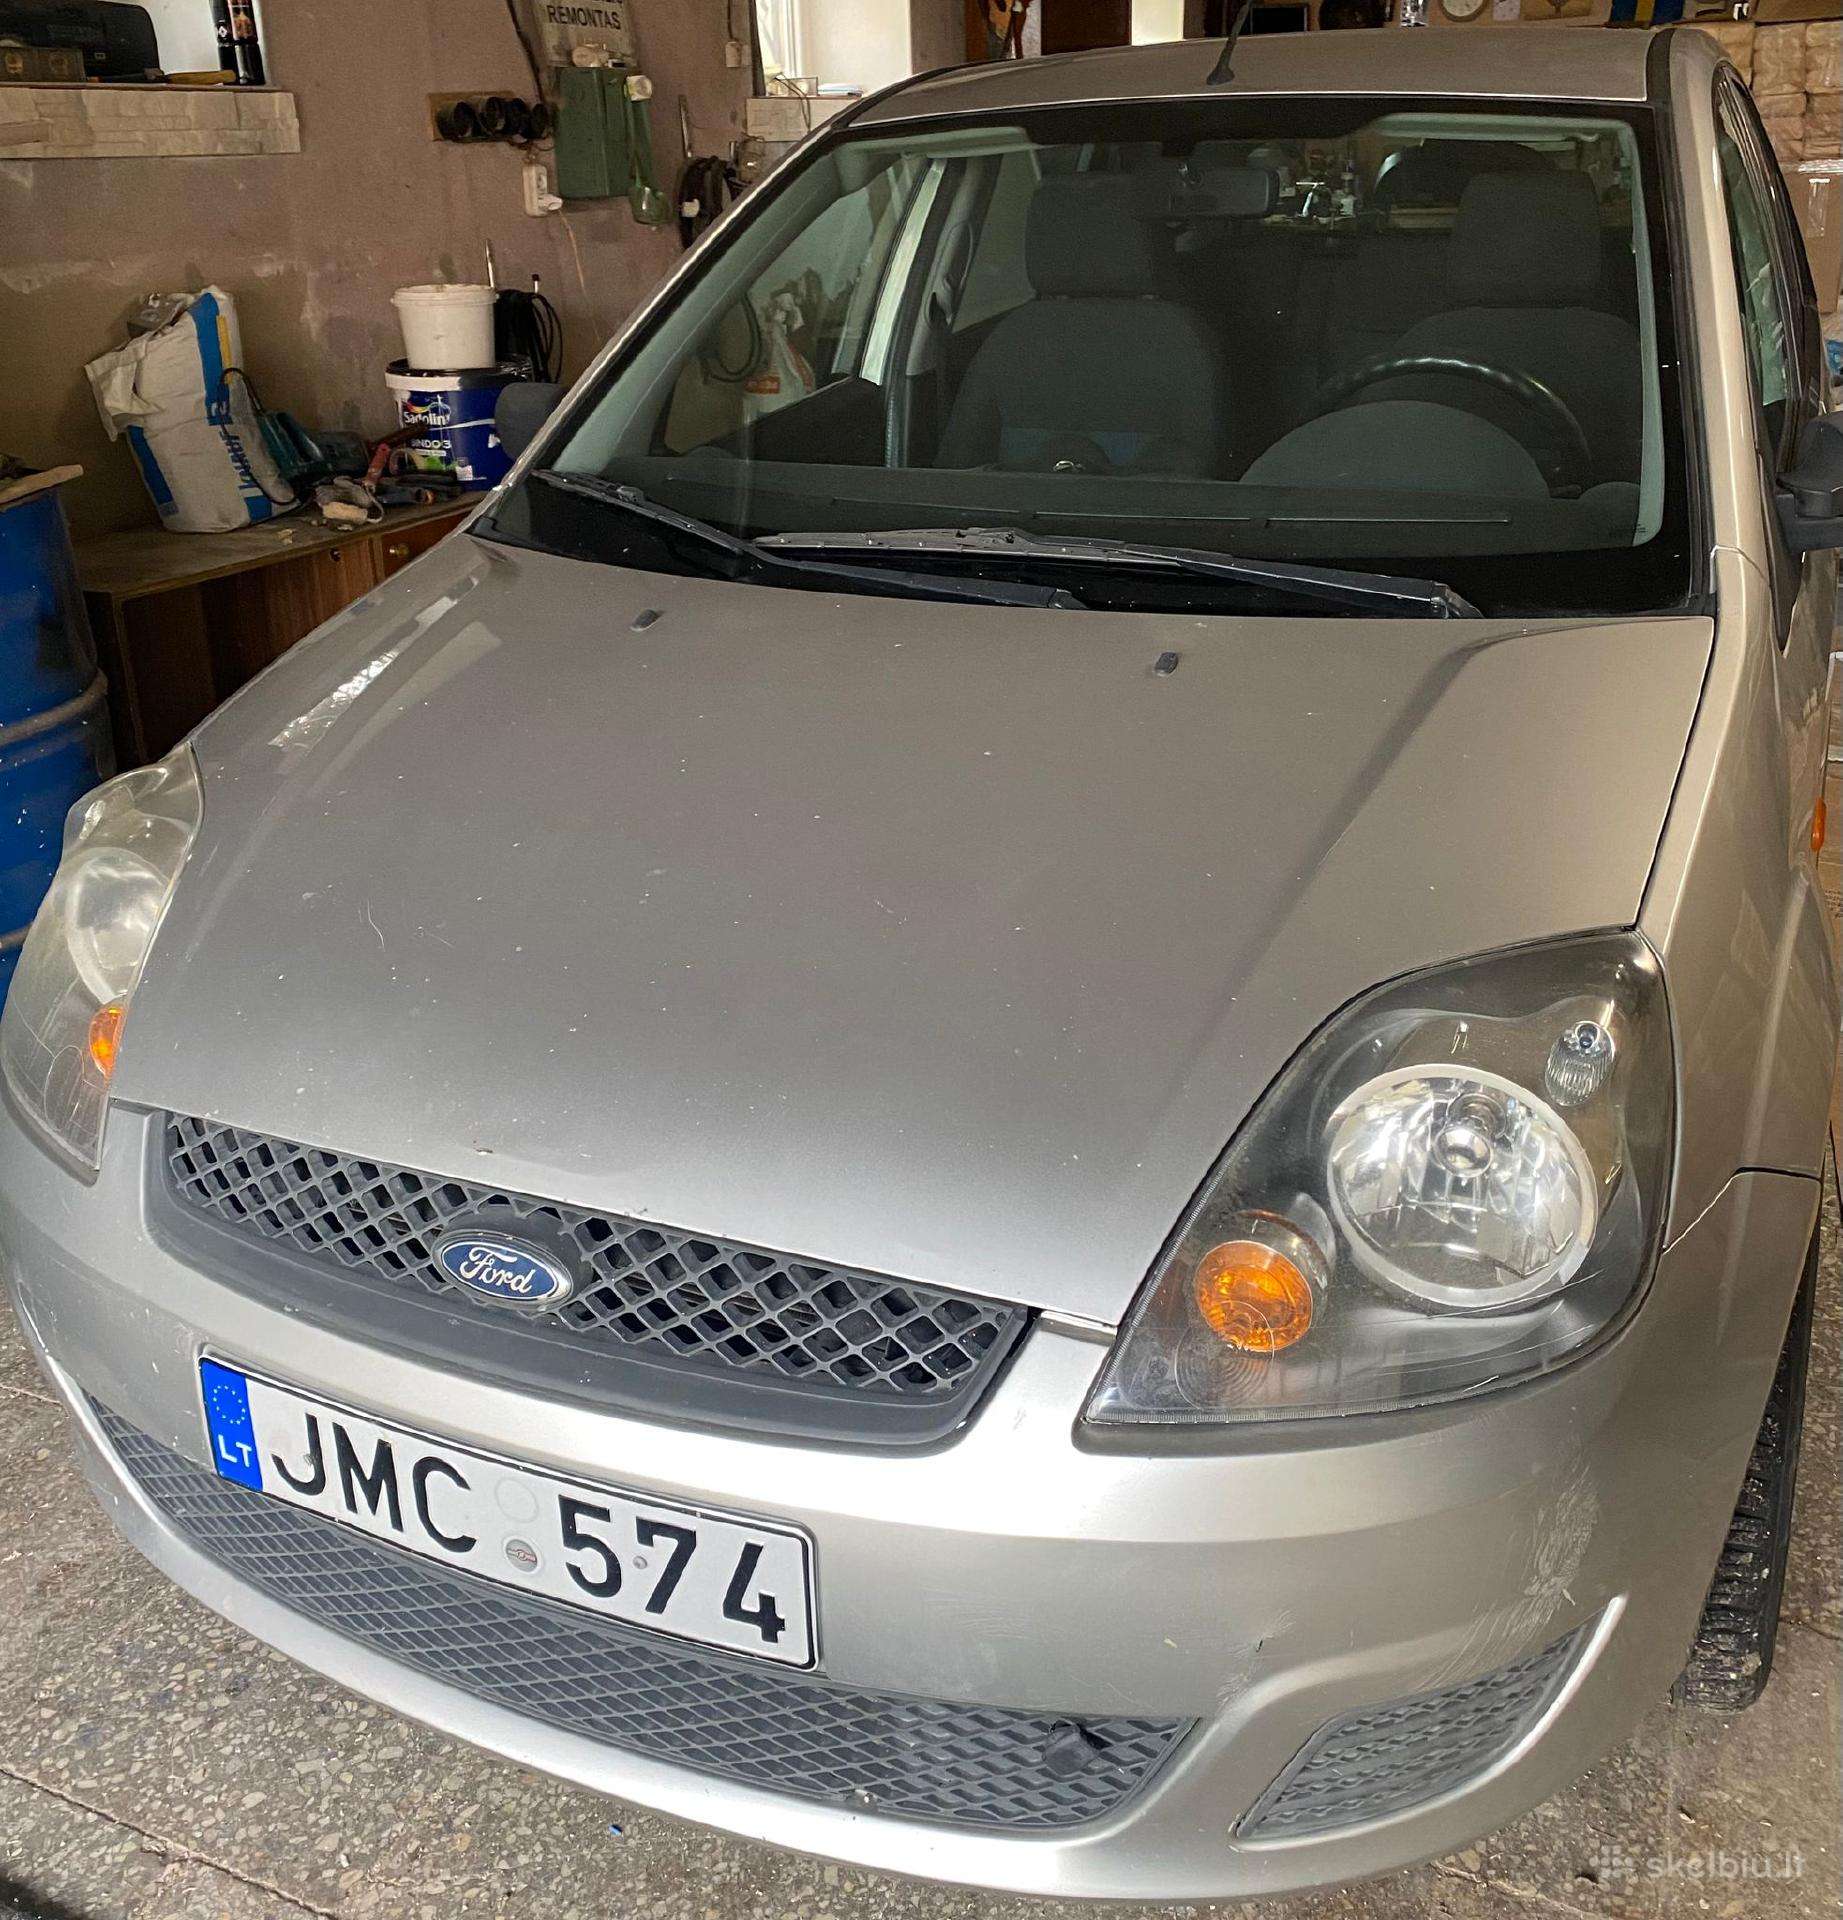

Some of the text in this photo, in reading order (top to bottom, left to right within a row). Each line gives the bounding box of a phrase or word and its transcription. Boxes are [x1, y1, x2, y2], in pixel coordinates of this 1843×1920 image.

[546, 5, 621, 30] REMONTAS
[459, 1247, 536, 1294] Ford
[218, 1434, 253, 1468] LT
[271, 1412, 786, 1644] JMC 574
